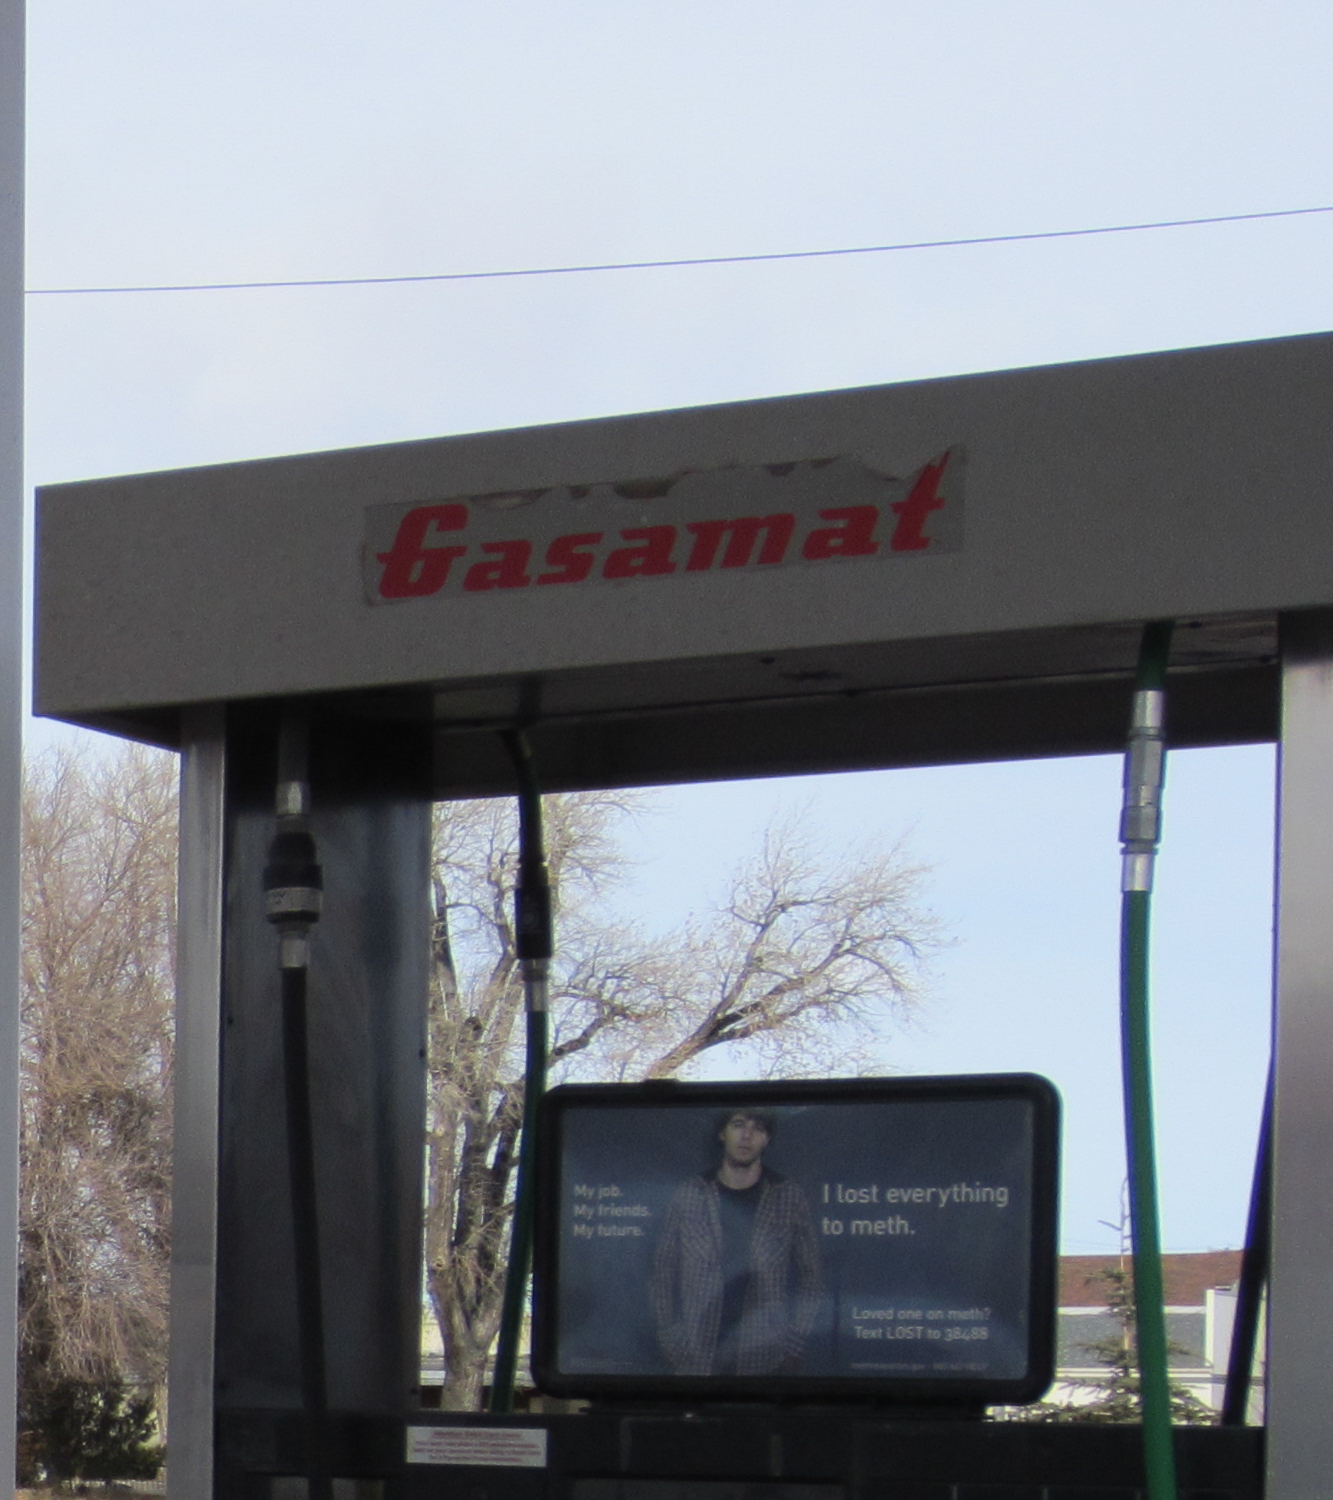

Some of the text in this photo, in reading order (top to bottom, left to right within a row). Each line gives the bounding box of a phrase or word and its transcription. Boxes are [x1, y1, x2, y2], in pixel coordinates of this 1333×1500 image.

[376, 450, 951, 599] Gasamat
[573, 1184, 594, 1200] My
[823, 1181, 1009, 1208] I lost everything
[573, 1204, 594, 1220] My
[573, 1224, 594, 1240] My
[822, 1214, 915, 1236] to meth.
[852, 1306, 992, 1321] Loved one on meth?
[854, 1326, 884, 1340] Text
[887, 1326, 924, 1341] LOST
[927, 1328, 941, 1340] to
